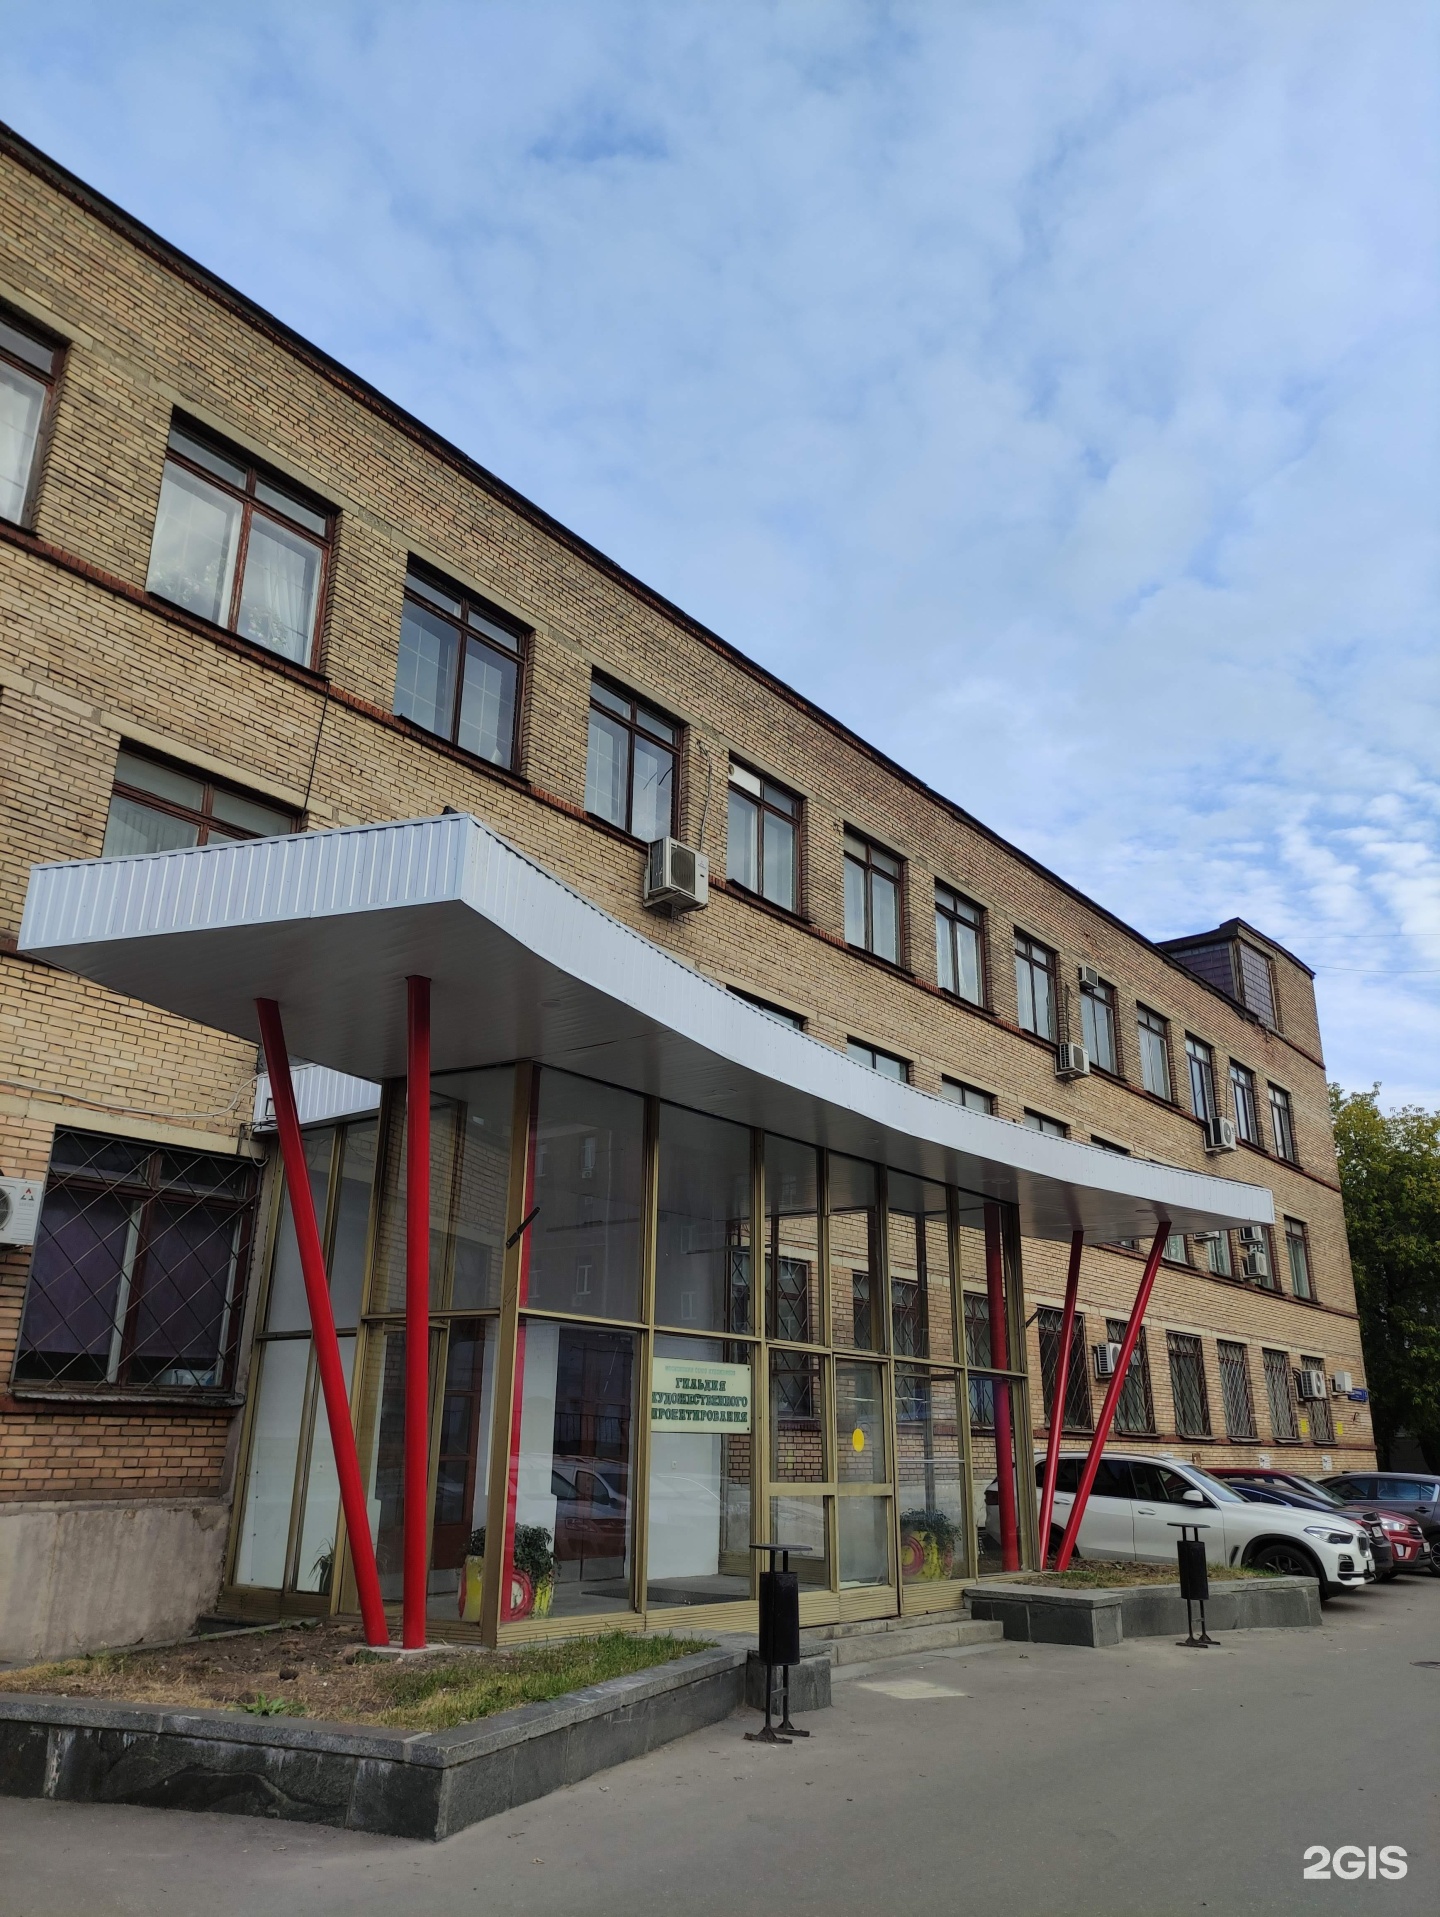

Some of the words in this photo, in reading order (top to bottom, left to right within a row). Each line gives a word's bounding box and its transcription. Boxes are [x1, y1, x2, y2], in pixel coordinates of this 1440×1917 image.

[675, 1377, 726, 1391] ГИЛЬДИЯ
[652, 1392, 748, 1407] ХУДОЖЕСТВЕННОГО
[651, 1408, 748, 1422] ПРОЕКТИРОВАНИЯ
